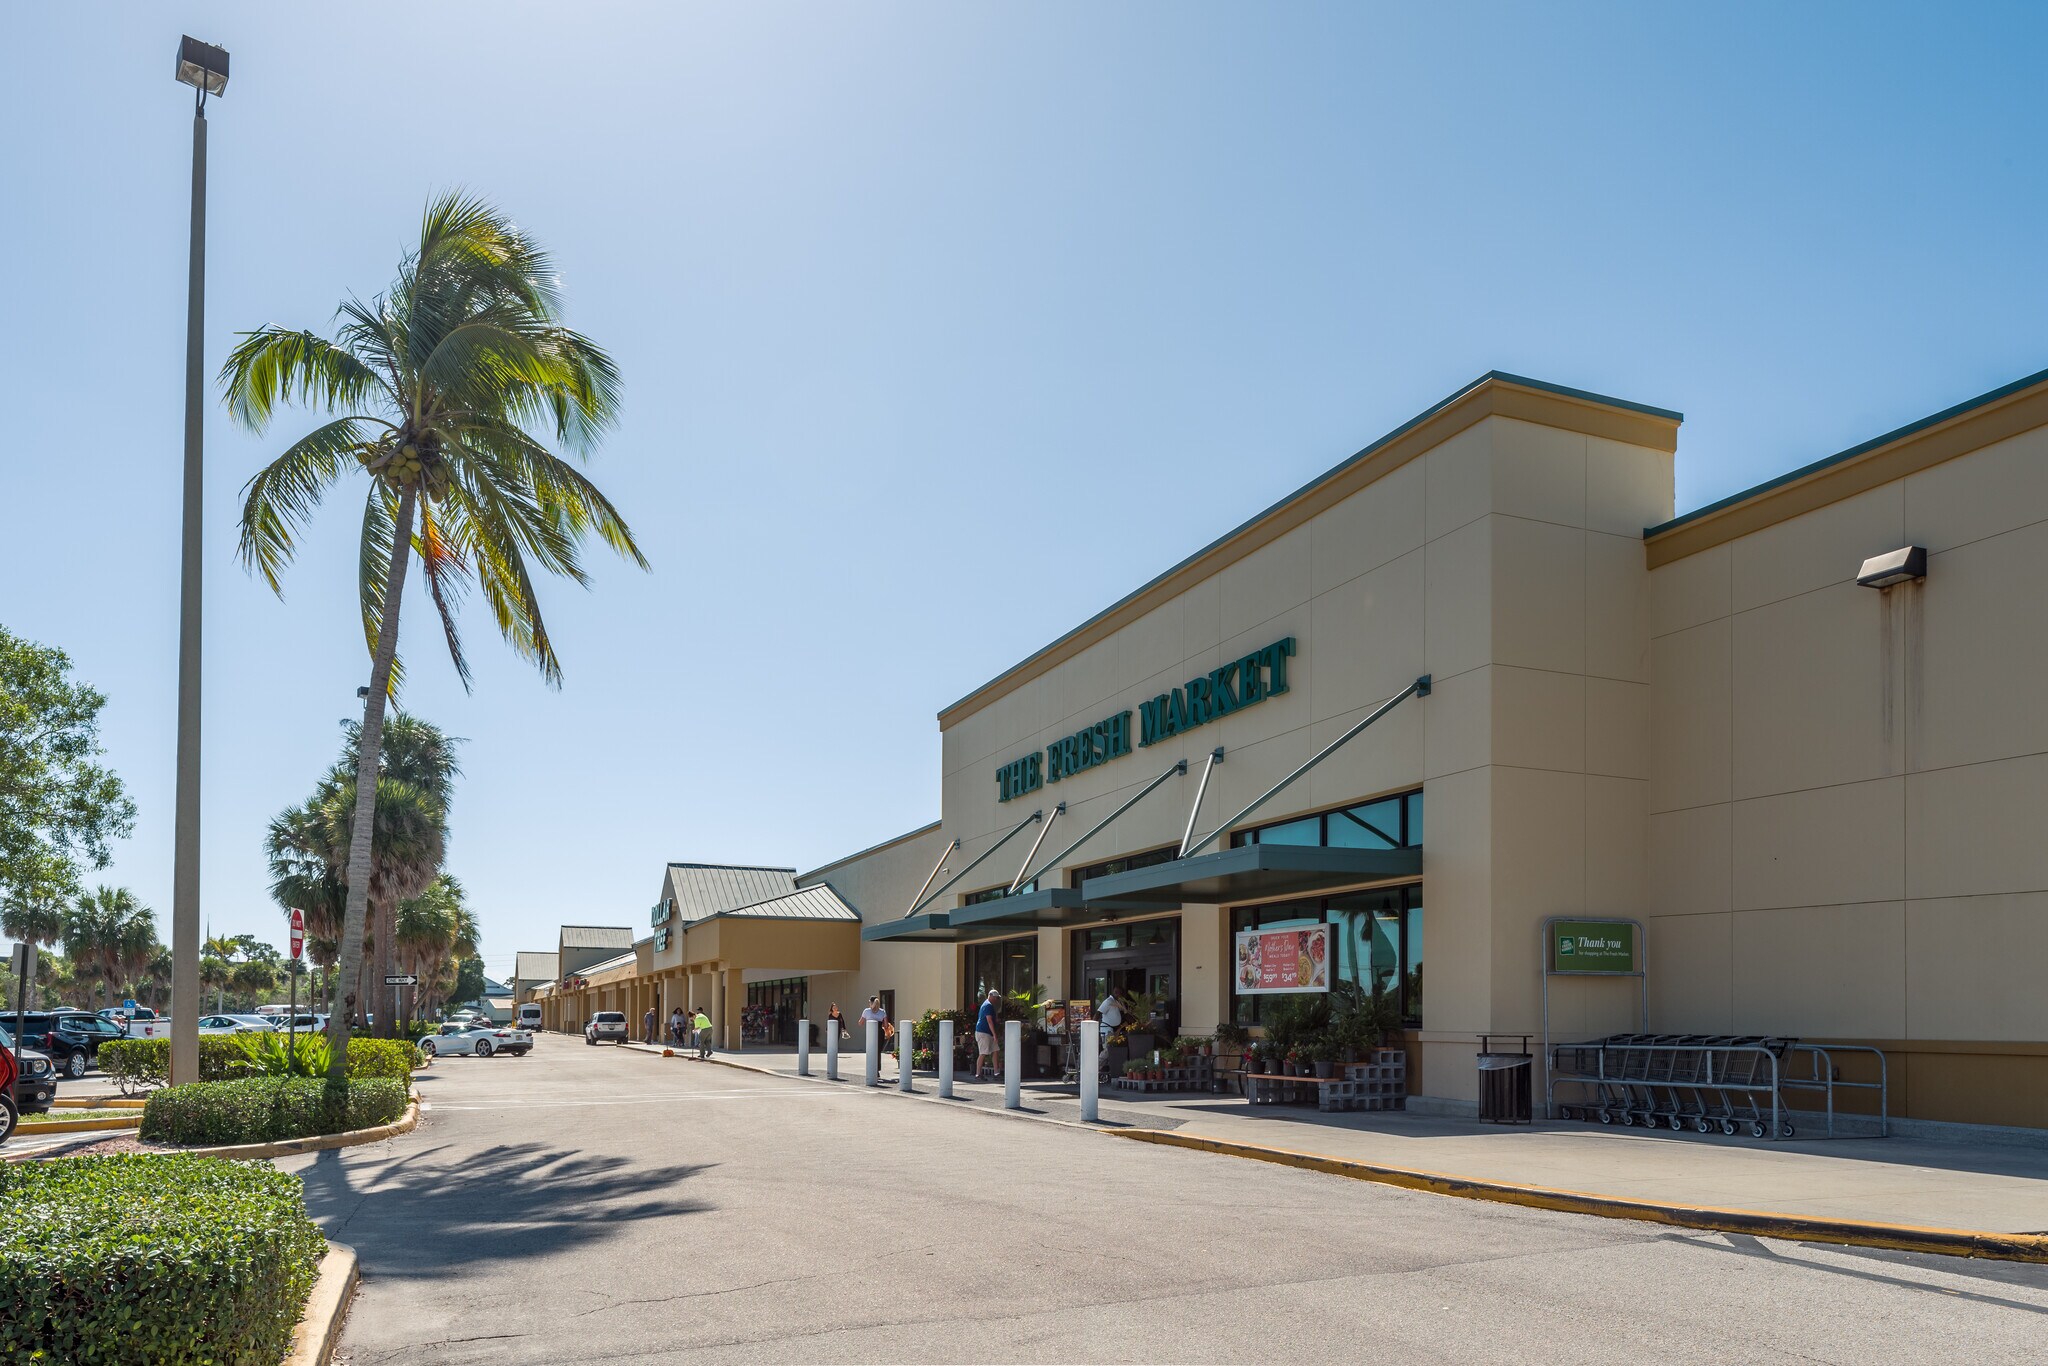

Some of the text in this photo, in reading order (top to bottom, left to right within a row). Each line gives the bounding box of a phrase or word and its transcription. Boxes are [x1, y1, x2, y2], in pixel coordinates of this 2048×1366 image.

[996, 636, 1297, 803] THE FRESH MARKET
[292, 940, 300, 949] ENTER
[1578, 936, 1621, 950] Thank you
